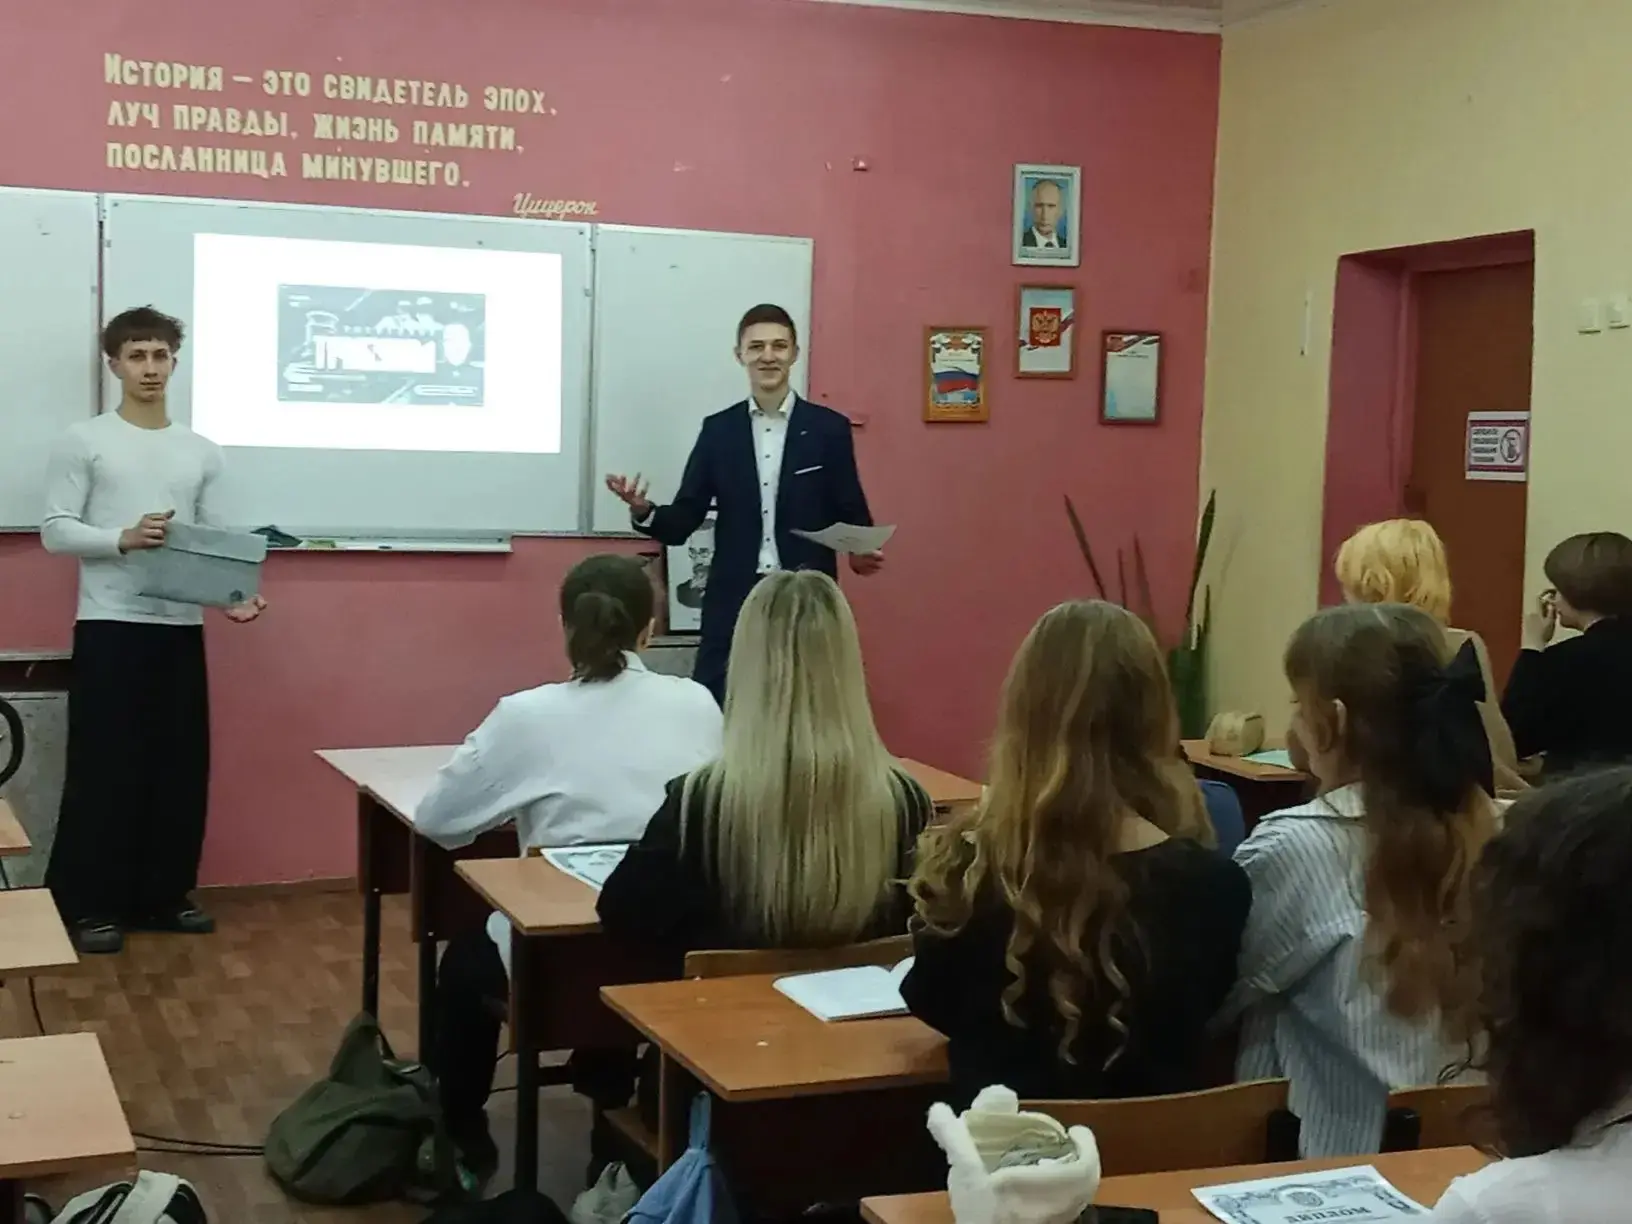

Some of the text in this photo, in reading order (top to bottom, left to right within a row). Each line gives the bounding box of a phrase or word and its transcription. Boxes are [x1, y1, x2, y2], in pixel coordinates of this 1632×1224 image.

[262, 69, 311, 97] ЭТО
[323, 73, 469, 109] СВИДЕТЕЛЬ
[107, 100, 160, 129] ЛУЧ
[313, 112, 399, 143] ЖИЗНЬ
[106, 142, 470, 187] ПОСЛАННИЦА МИНУВШЕГО.
[512, 192, 599, 219] Цицерон
